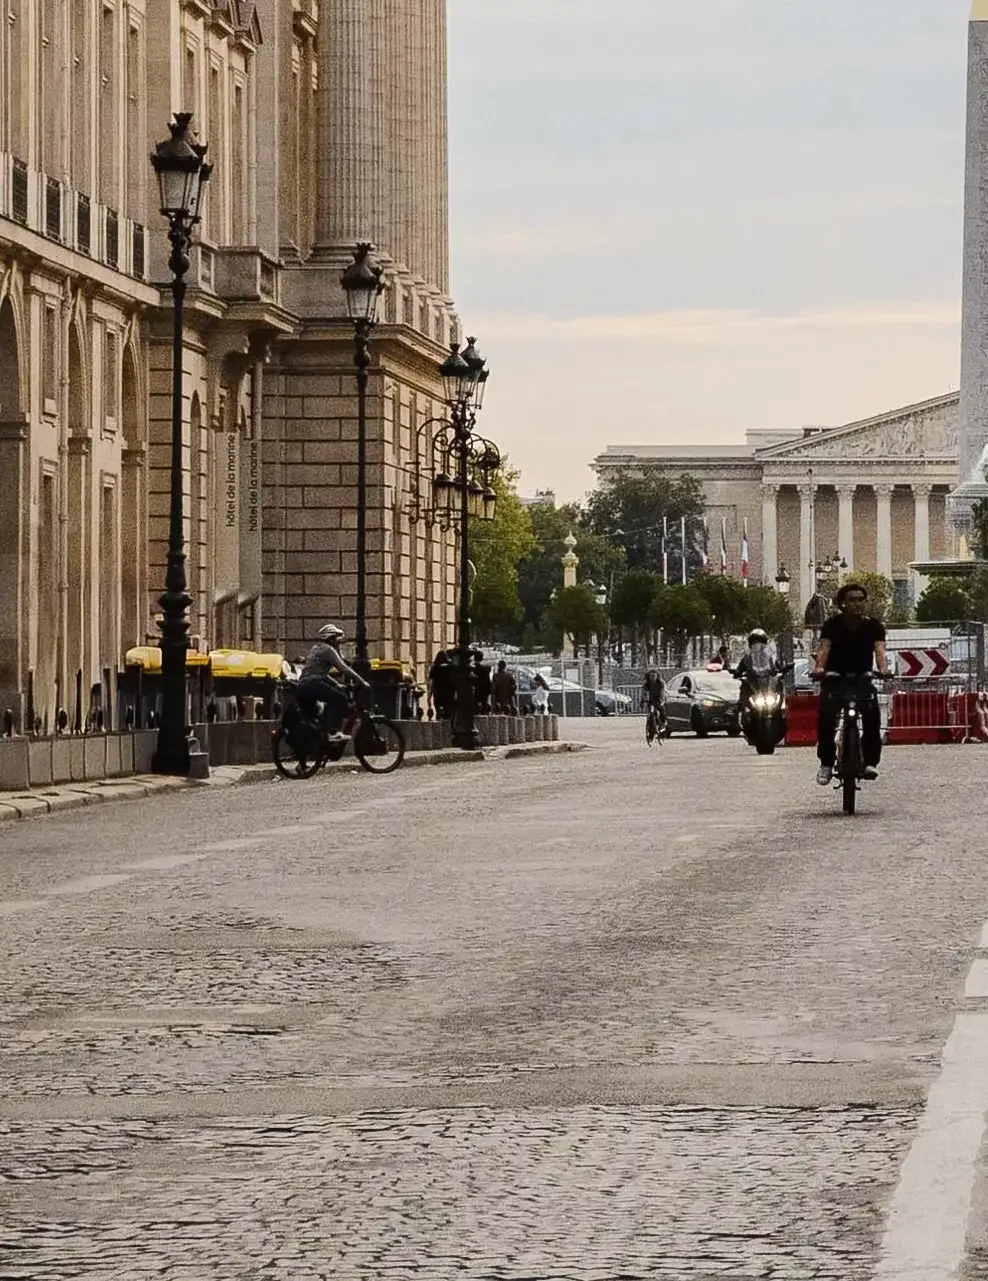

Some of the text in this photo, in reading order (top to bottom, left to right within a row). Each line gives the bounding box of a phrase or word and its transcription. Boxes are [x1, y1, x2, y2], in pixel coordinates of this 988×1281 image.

[226, 473, 236, 483] la
[248, 479, 258, 489] la
[226, 484, 236, 499] de
[248, 491, 258, 504] de
